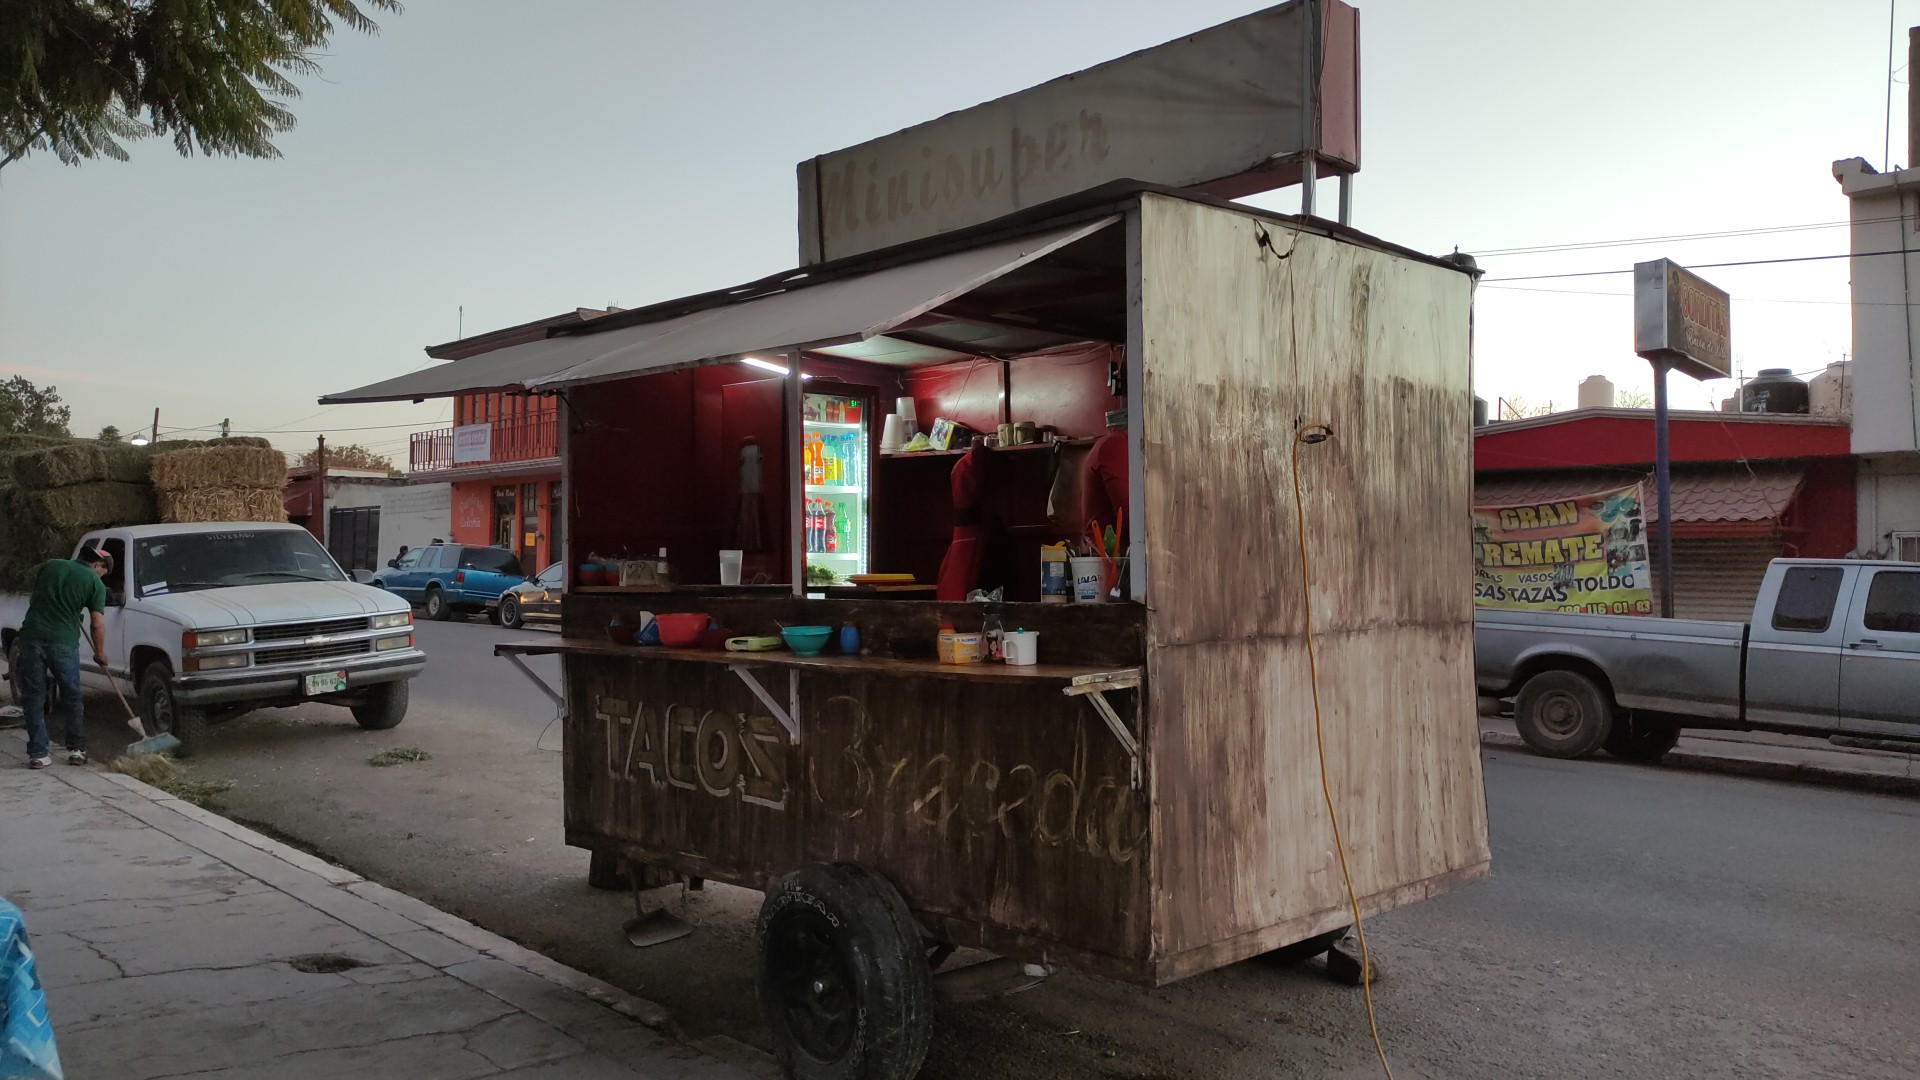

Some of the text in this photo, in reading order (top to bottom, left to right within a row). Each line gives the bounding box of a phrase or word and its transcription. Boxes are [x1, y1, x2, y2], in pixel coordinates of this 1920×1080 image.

[1681, 282, 1728, 339] GORDITAS
[1499, 501, 1579, 533] GRAN
[1482, 533, 1604, 568] REMATE
[1077, 575, 1098, 585] LALA
[1518, 572, 1555, 584] VASOS
[1573, 573, 1635, 593] TOLDO
[1507, 585, 1568, 604] TAZAS
[1586, 602, 1608, 615] 116
[1612, 600, 1629, 615] 01
[1635, 599, 1653, 614] 83
[595, 694, 789, 811] TACOS
